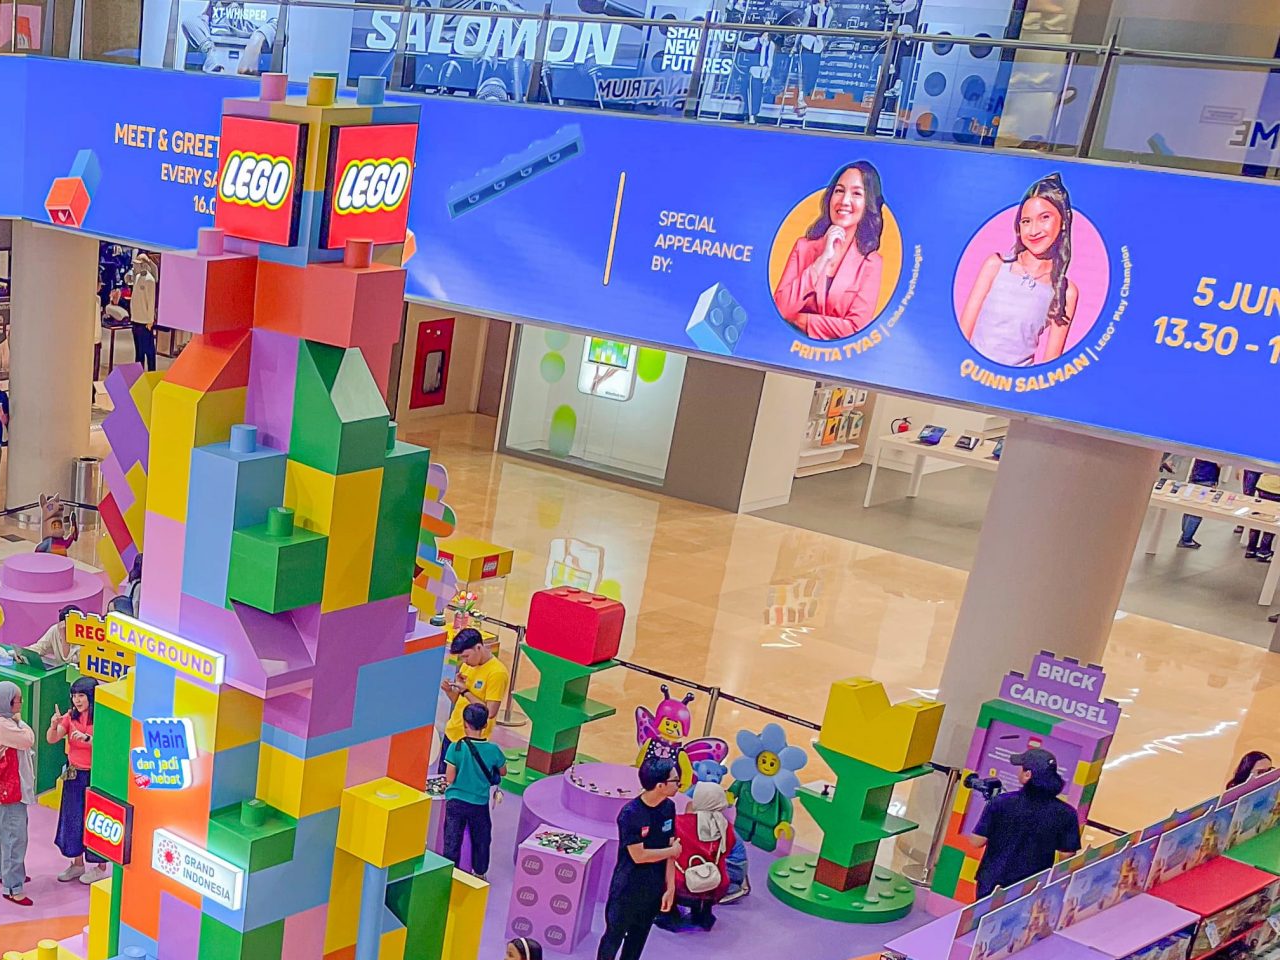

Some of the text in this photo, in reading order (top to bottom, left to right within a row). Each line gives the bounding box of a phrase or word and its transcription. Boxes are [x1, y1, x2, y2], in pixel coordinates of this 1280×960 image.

[114, 122, 155, 149] MEET
[157, 130, 168, 151] &
[161, 163, 203, 187] EVERY
[221, 151, 292, 208] LEGO
[336, 159, 411, 213] LEGO
[658, 210, 717, 233] SPECIAL
[654, 233, 754, 262] APPEARANCE
[651, 255, 672, 274] BY:
[1120, 245, 1133, 298] Champion
[1192, 276, 1217, 307] 5
[1112, 299, 1130, 322] Play
[789, 340, 843, 362] PRITTA
[843, 329, 882, 360] TYAS
[1153, 315, 1239, 356] 13.30
[960, 358, 1013, 392] QUINN
[1014, 353, 1090, 393] SALMAN
[109, 621, 214, 677] PLAYGROUND
[1037, 662, 1097, 692] BRICK
[1009, 683, 1109, 725] CAROUSEL
[148, 728, 185, 750] Main
[136, 756, 179, 772] dan jadi
[150, 770, 181, 785] hebat
[86, 809, 123, 845] LEGO
[184, 854, 215, 878] GRAND
[182, 867, 231, 901] INDONESIA
